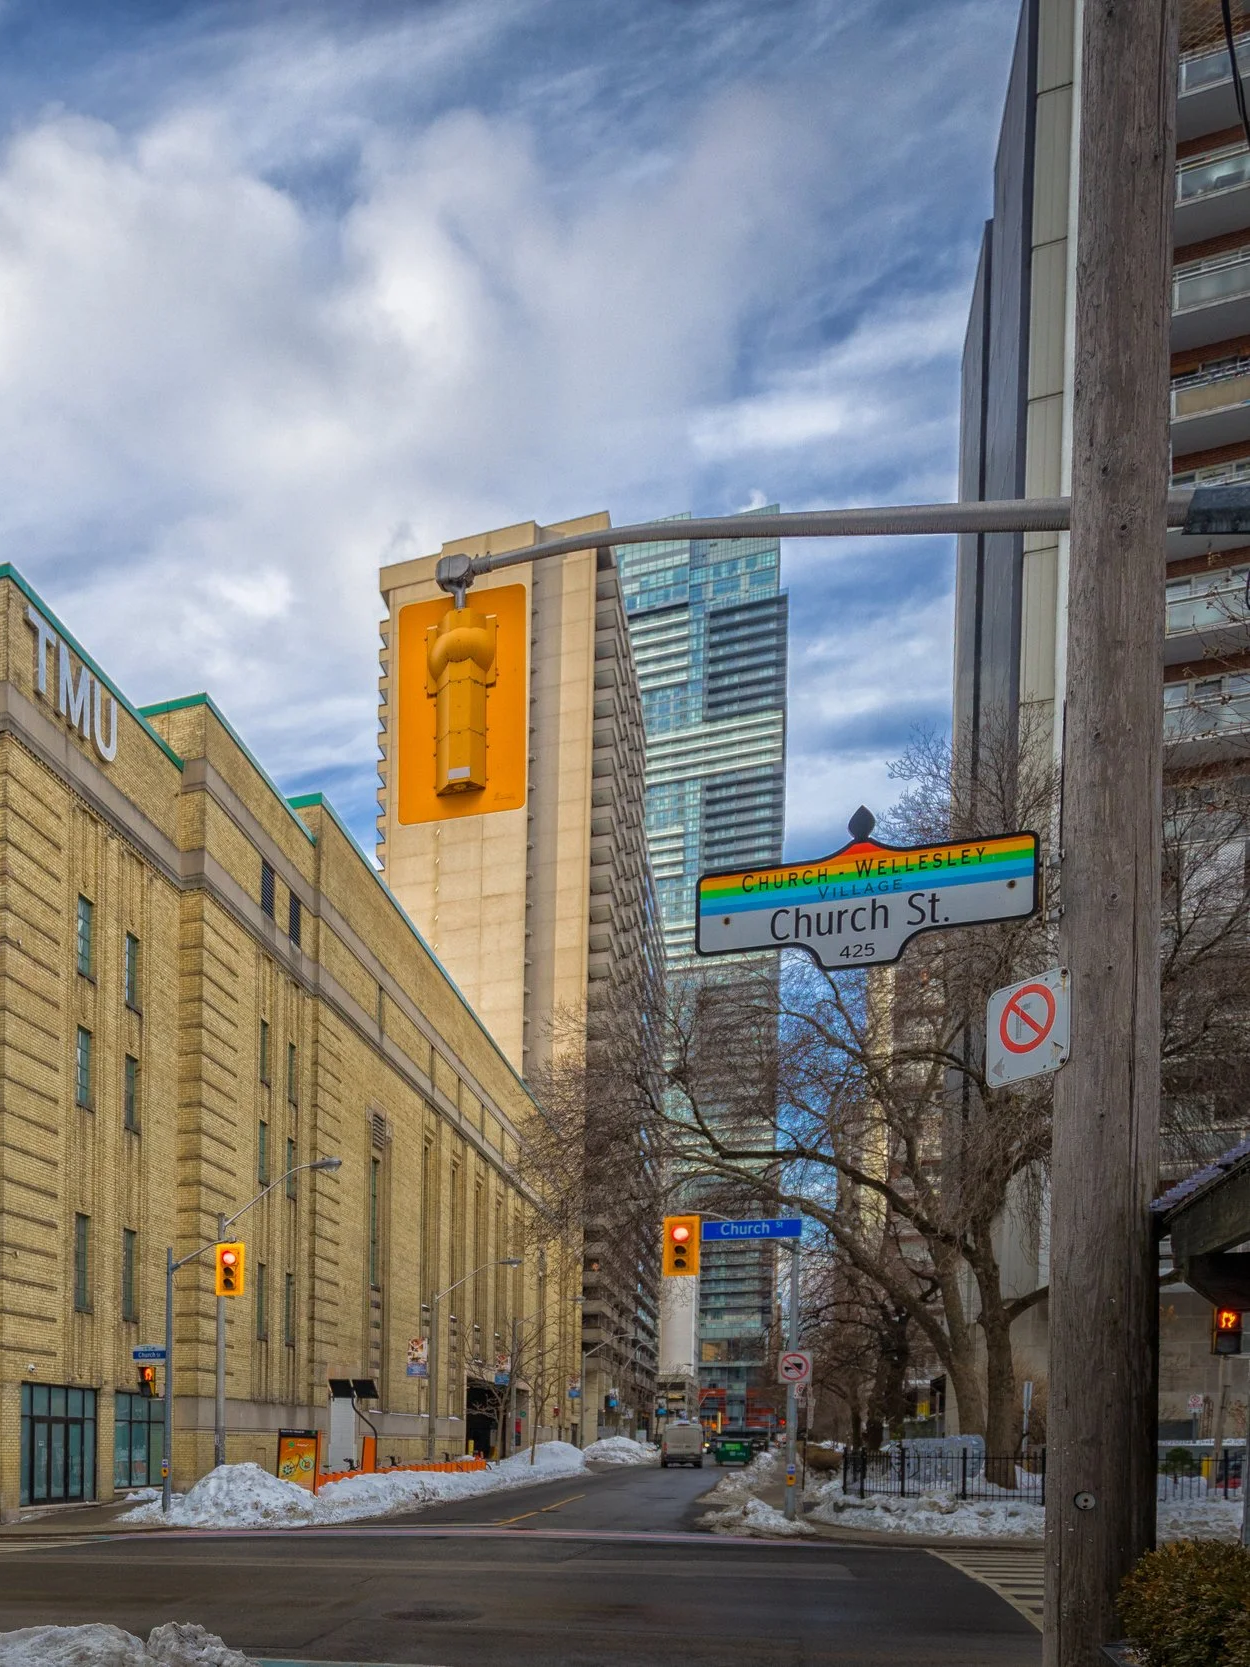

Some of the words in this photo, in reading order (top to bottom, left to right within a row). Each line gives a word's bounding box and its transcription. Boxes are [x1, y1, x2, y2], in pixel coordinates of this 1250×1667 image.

[25, 604, 118, 762] TMU
[741, 867, 828, 893] CHURCH
[855, 846, 987, 878] WELLESLEY
[817, 878, 903, 899] VILLAGE
[770, 898, 889, 941] Church
[907, 892, 950, 926] St.
[839, 943, 876, 959] 425
[720, 1222, 770, 1236] Church
[775, 1221, 784, 1229] St
